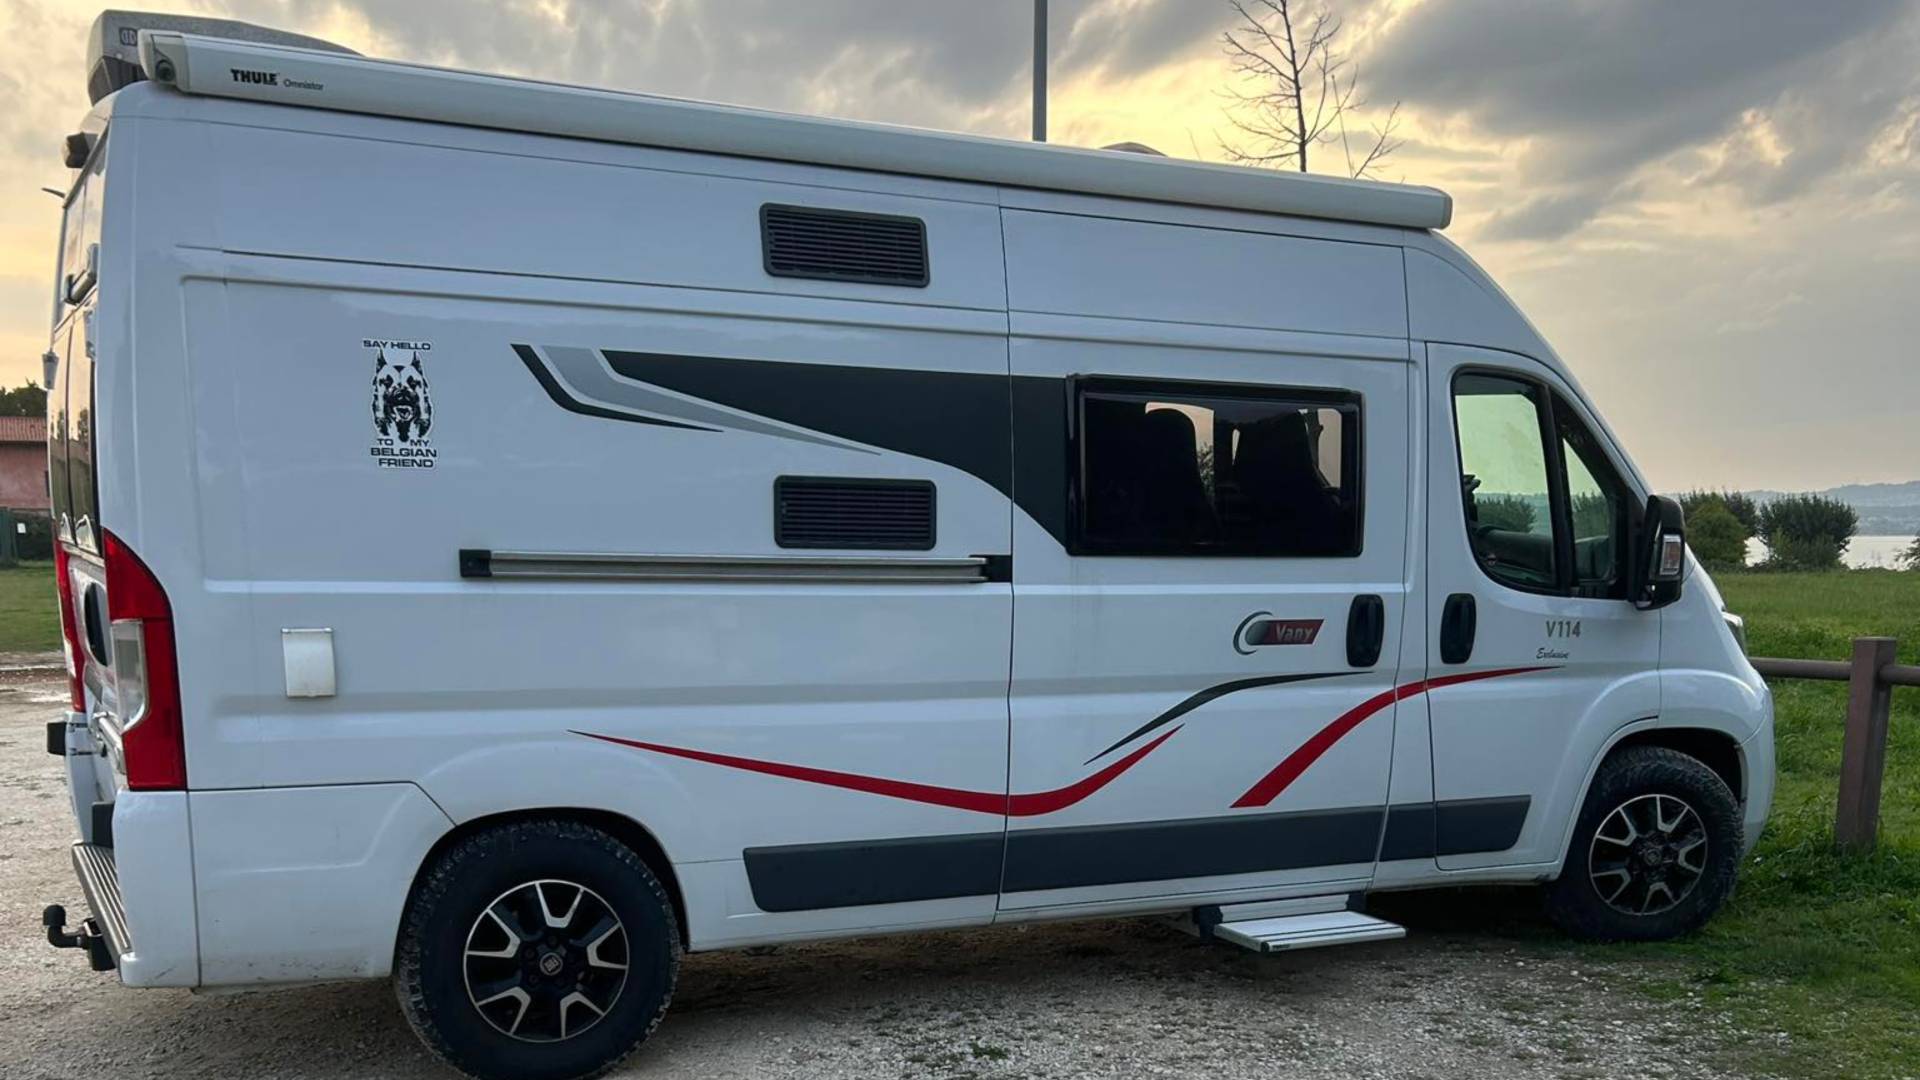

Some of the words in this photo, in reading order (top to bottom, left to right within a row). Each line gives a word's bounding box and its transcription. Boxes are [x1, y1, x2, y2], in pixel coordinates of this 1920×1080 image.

[230, 69, 278, 86] THULE
[363, 340, 388, 348] SAY
[390, 342, 431, 350] HELLO
[377, 438, 394, 446] TO
[410, 439, 430, 447] MY
[370, 447, 437, 458] BELGIAN
[378, 458, 434, 468] FRIEND
[1275, 624, 1313, 641] Vany
[1546, 620, 1581, 638] V114
